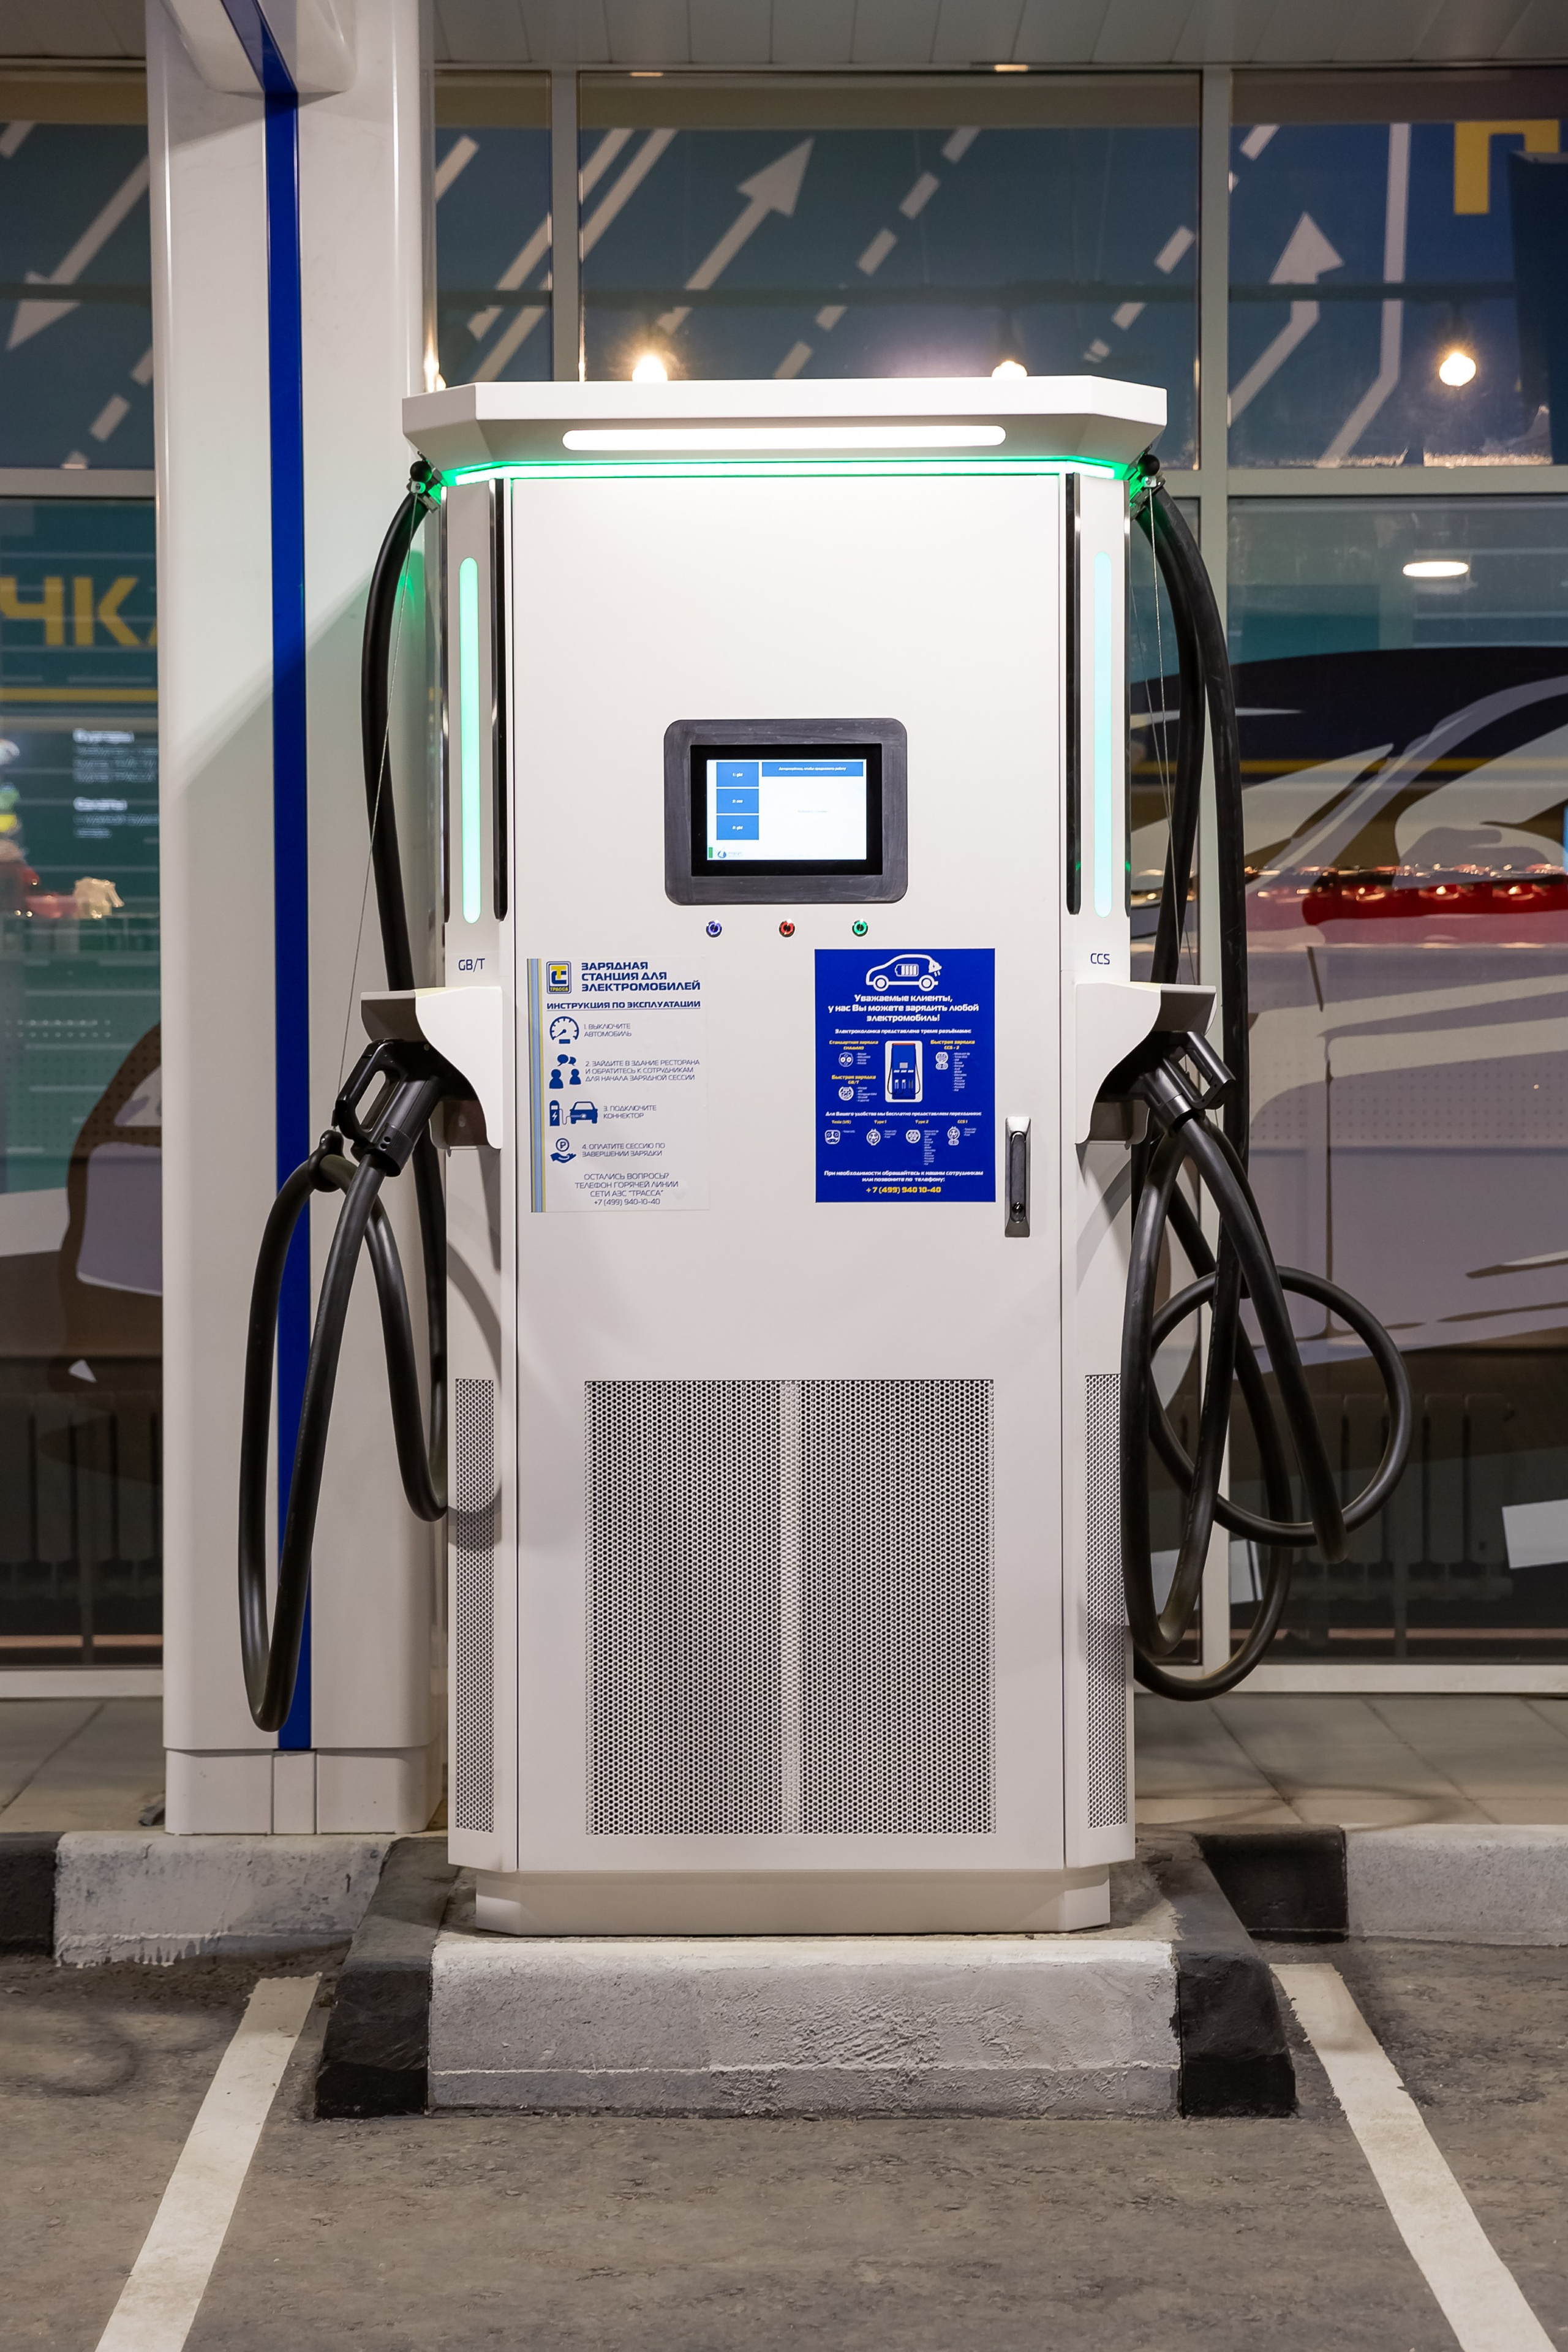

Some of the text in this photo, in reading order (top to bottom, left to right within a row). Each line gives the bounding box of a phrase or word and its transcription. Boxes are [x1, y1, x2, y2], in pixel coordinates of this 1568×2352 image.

[0, 576, 157, 646] ЧК
[458, 958, 485, 972] GB/T
[1090, 953, 1110, 965] CCS
[581, 973, 639, 981] СТАНЦИЯ
[581, 980, 701, 992] ЭЛЕКТРОМОБИЛЕЙ
[949, 1003, 979, 1012] любой
[867, 1014, 940, 1023] электромобиль!
